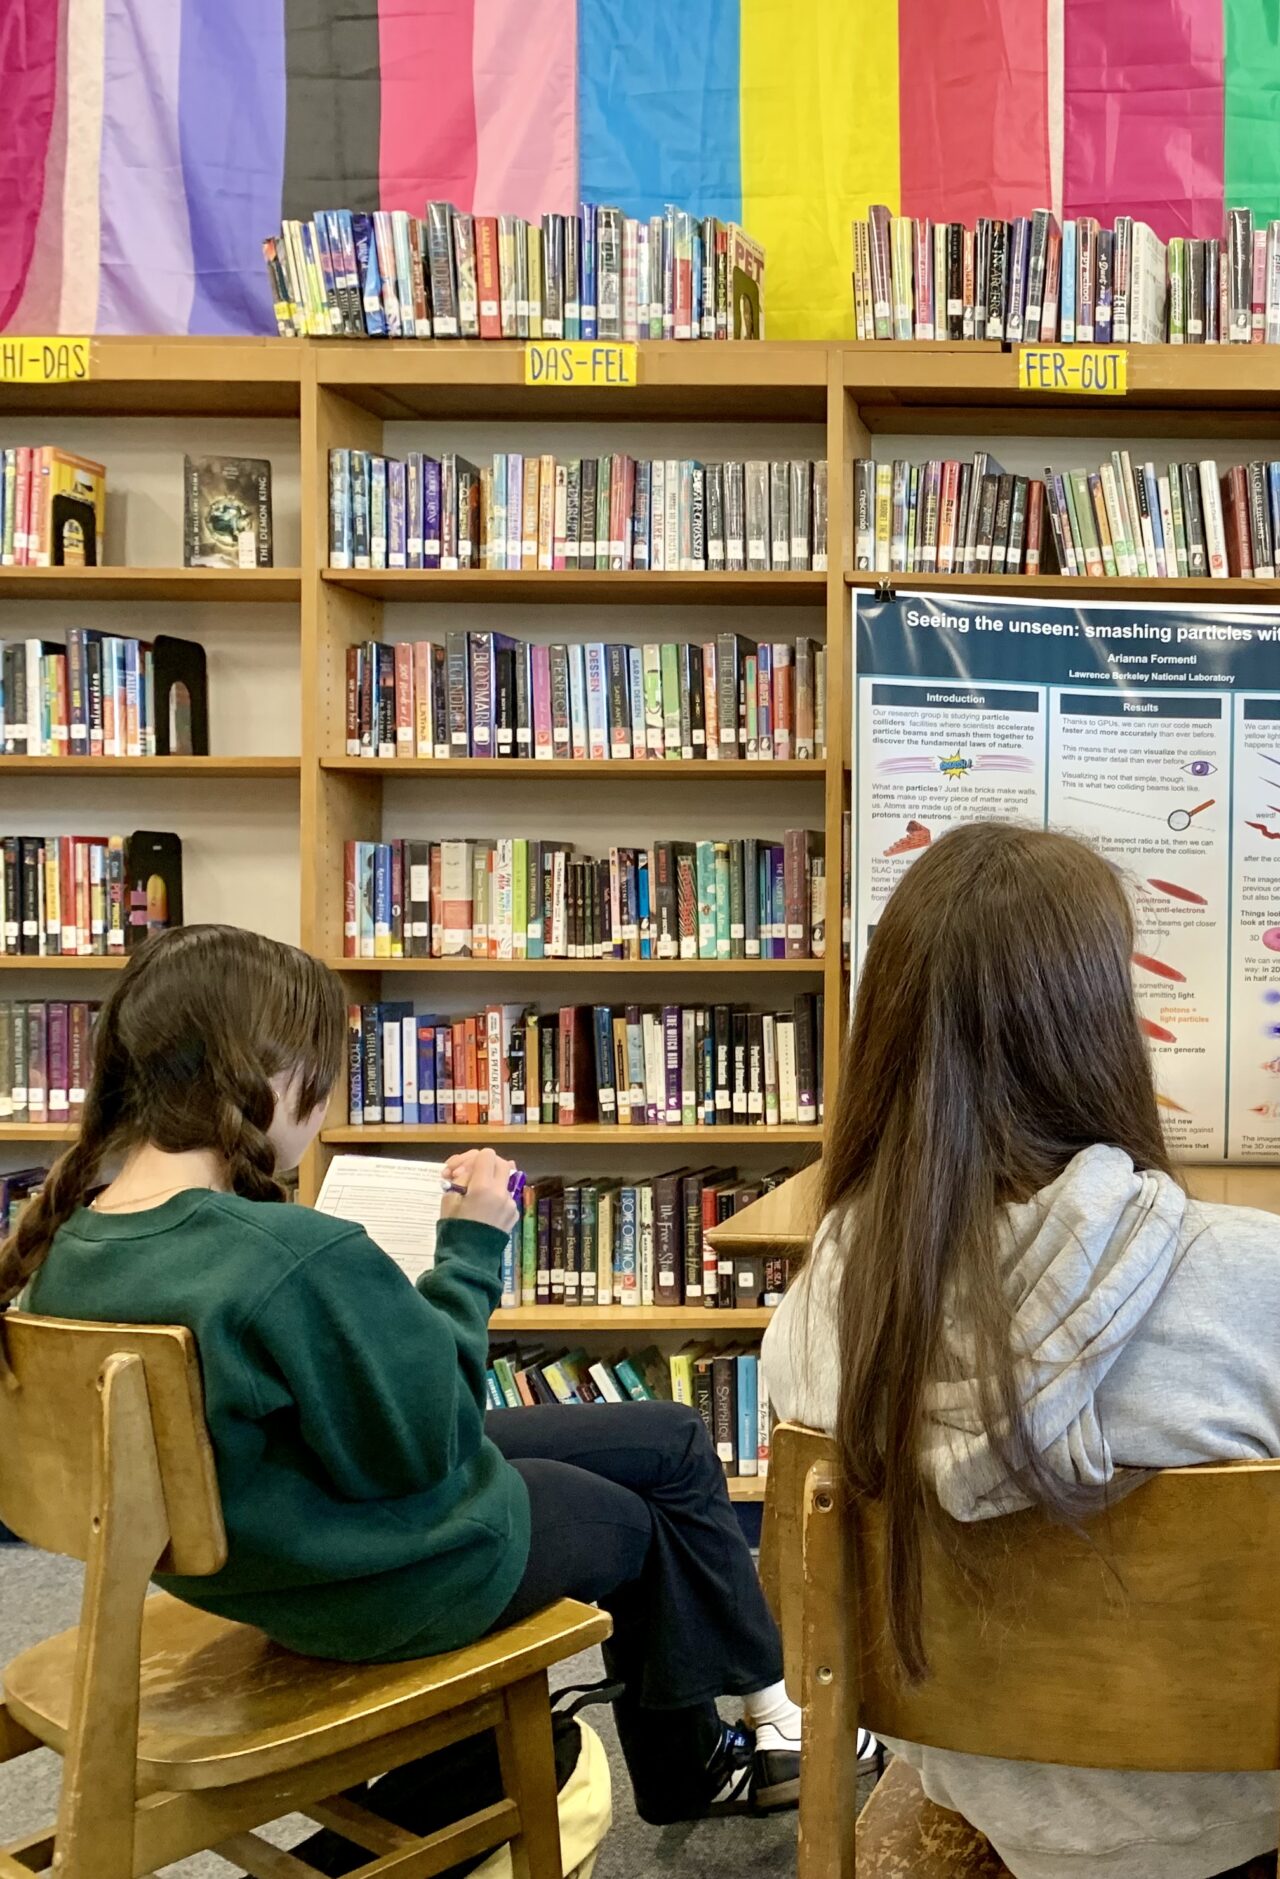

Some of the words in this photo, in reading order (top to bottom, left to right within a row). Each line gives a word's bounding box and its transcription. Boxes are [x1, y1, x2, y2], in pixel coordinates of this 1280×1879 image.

[530, 348, 629, 383] DAS-FEL
[1025, 353, 1120, 391] FER-GUT
[258, 477, 267, 501] KING
[259, 504, 268, 540] DEMON
[907, 611, 970, 632] Seeing
[975, 615, 1003, 631] the
[1009, 619, 1080, 637] unseen:
[1085, 624, 1171, 642] smashing
[1177, 624, 1253, 643] particles
[1107, 653, 1147, 664] Arianna
[1151, 653, 1197, 665] Formenti
[589, 649, 600, 693] DESSEN
[1068, 669, 1110, 680] Lawrence
[1112, 671, 1149, 682] Berkeley
[1151, 672, 1187, 682] National
[1189, 672, 1235, 683] Laboratory
[927, 693, 985, 704] Introduction
[1123, 703, 1159, 712] Results
[888, 710, 919, 718] research
[921, 712, 941, 720] group
[950, 712, 980, 721] studying
[982, 714, 1009, 722] particle
[1063, 718, 1087, 726] Thanks
[1098, 720, 1120, 728] GPUs,
[873, 728, 900, 736] particle
[903, 729, 928, 737] beams
[993, 733, 1024, 741] together
[1120, 730, 1157, 738] accurately
[873, 737, 905, 745] discover
[921, 739, 967, 747] fundamental
[970, 740, 986, 748] laws
[872, 783, 890, 791] What
[906, 785, 942, 793] particles?
[975, 786, 995, 794] bricks
[1018, 788, 1038, 796] walls,
[1241, 910, 1265, 918] Things
